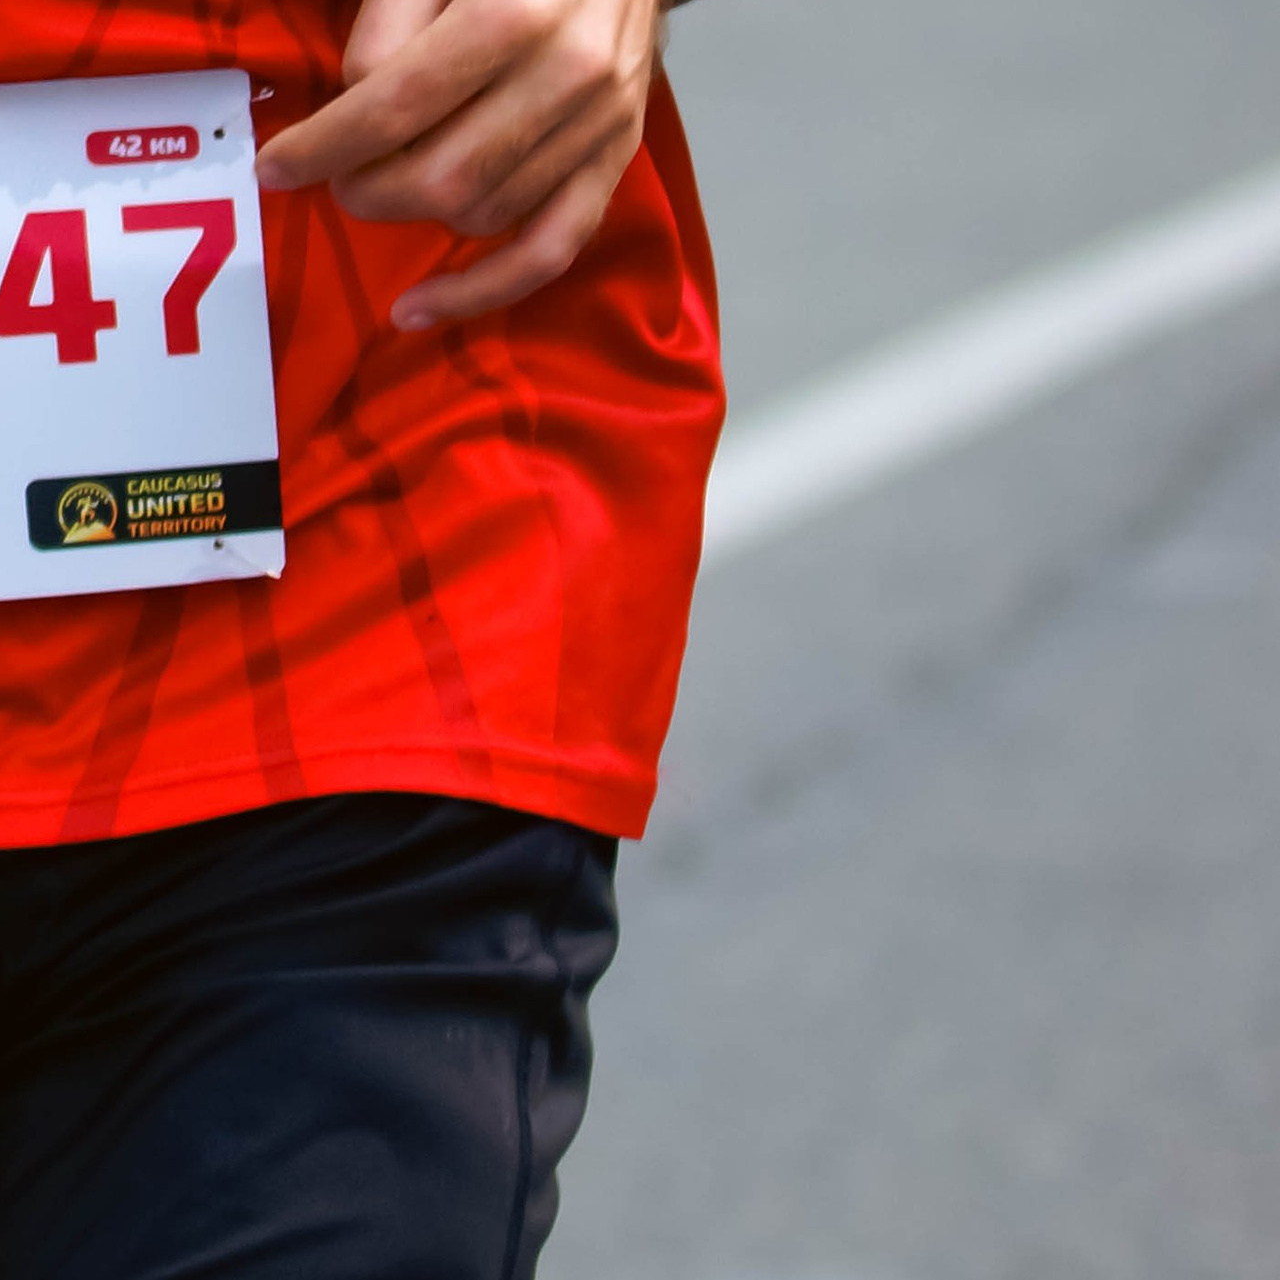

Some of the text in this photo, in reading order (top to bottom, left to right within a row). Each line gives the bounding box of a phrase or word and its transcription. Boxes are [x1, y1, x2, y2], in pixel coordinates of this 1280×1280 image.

[109, 135, 142, 157] 42
[127, 473, 222, 495] CAUCASUS
[127, 491, 225, 519] UNITED
[129, 514, 227, 538] TERRITORY
